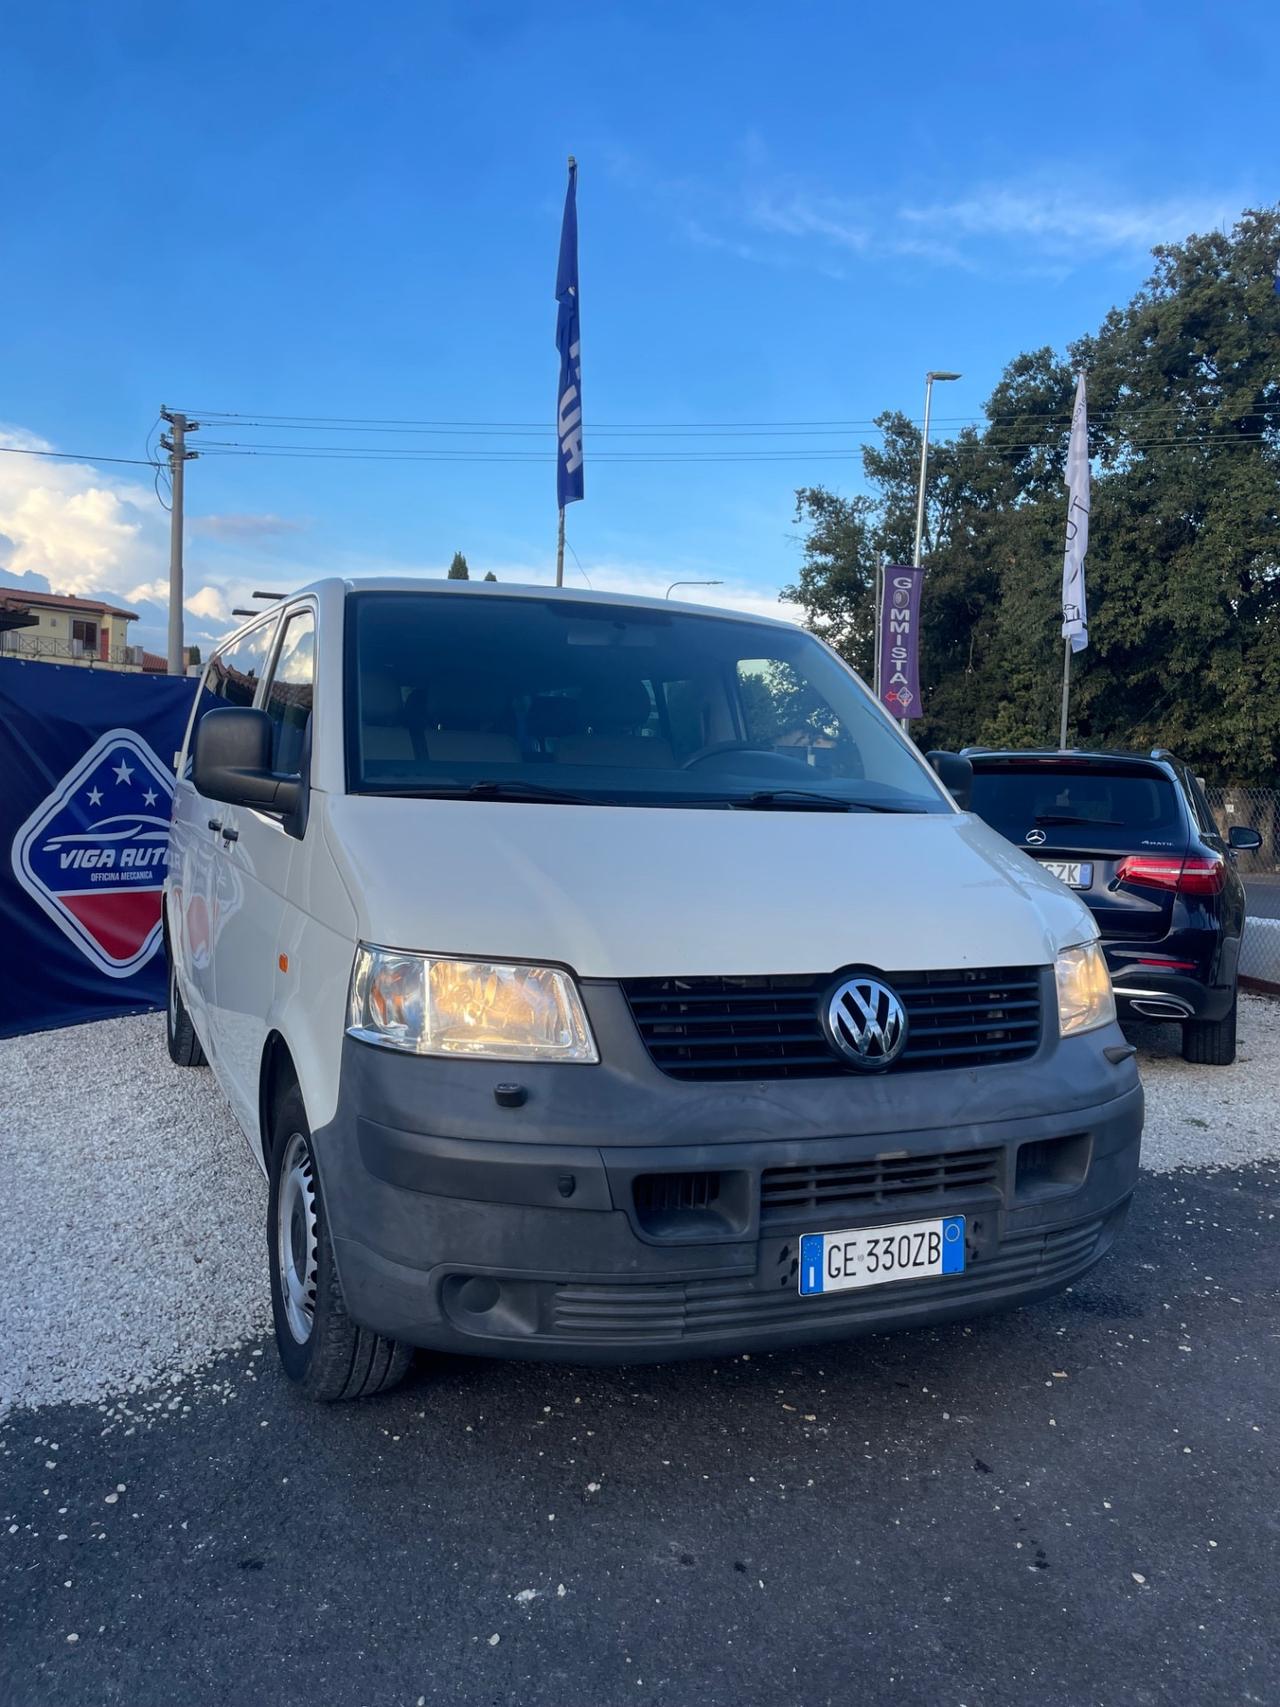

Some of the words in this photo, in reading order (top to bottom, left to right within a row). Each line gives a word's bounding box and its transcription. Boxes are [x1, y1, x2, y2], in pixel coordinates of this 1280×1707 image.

[889, 576, 913, 684] GOMMISTA
[60, 849, 116, 869] VIGA
[90, 872, 120, 882] OFFICINA
[120, 870, 153, 881] MECCANICA
[827, 1241, 857, 1279] GE
[866, 1231, 942, 1273] 330ZB
